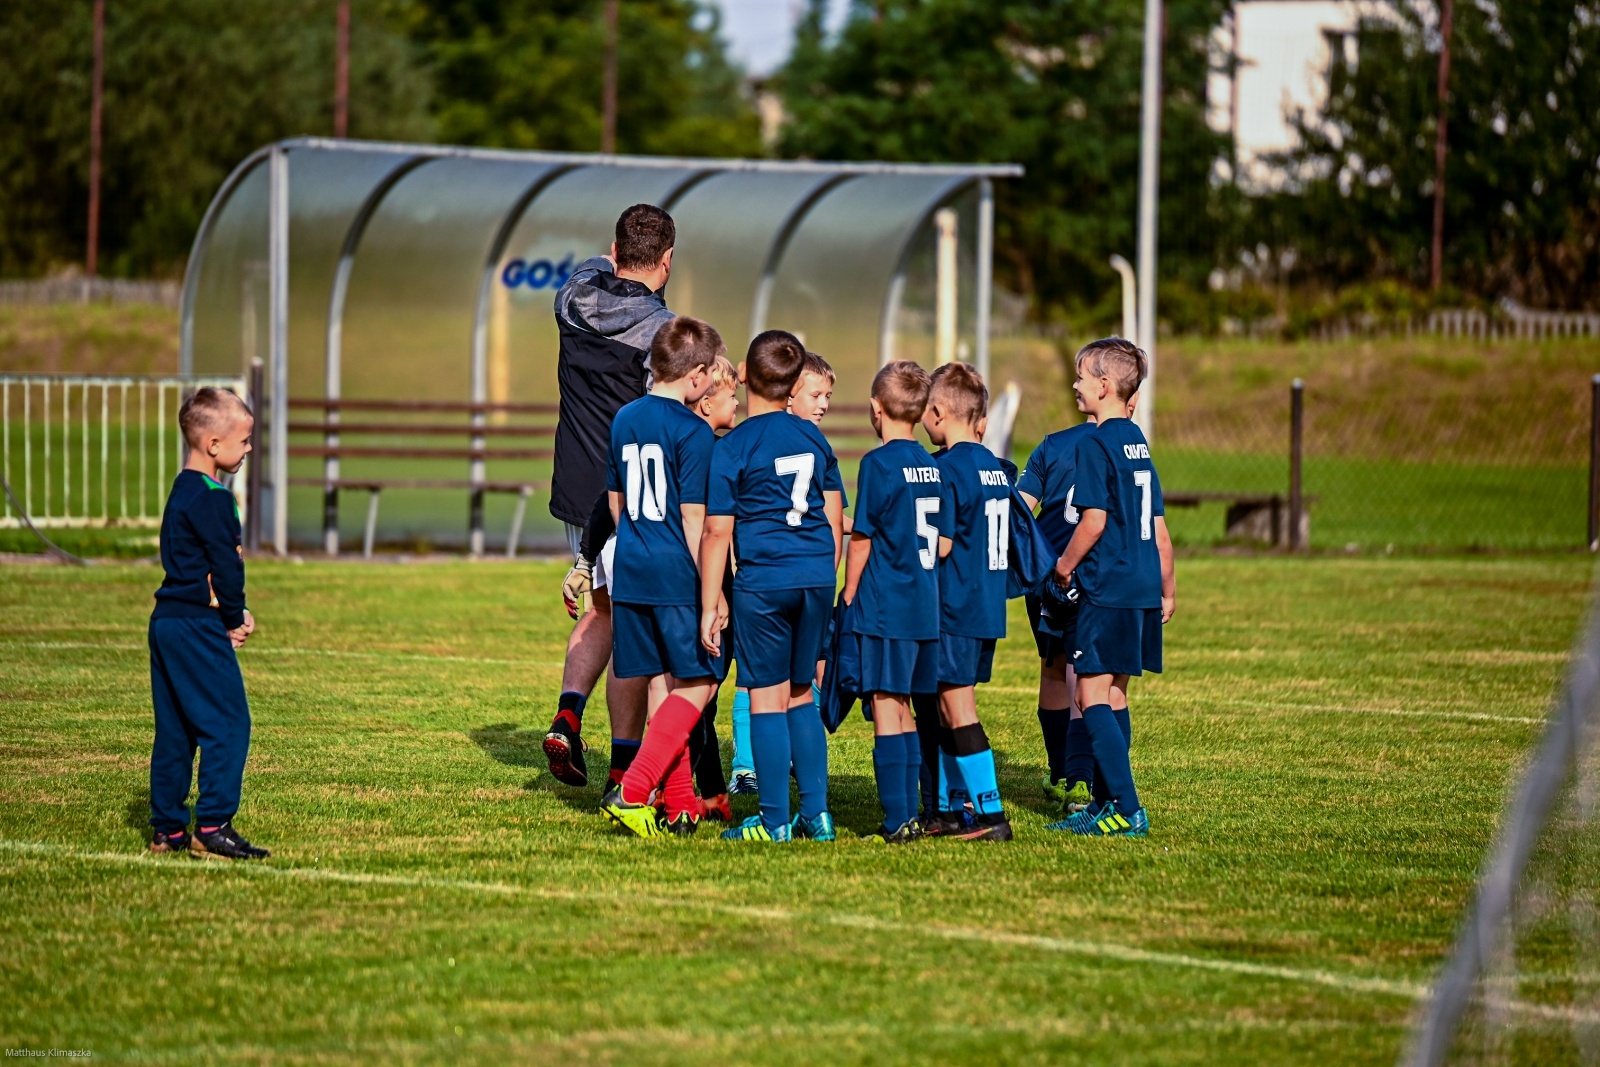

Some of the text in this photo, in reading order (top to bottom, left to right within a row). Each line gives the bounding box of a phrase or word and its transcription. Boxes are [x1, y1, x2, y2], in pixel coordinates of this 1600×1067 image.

[622, 443, 667, 522] 10
[774, 452, 815, 527] 7
[915, 496, 941, 570] 5
[984, 498, 1010, 571] 11
